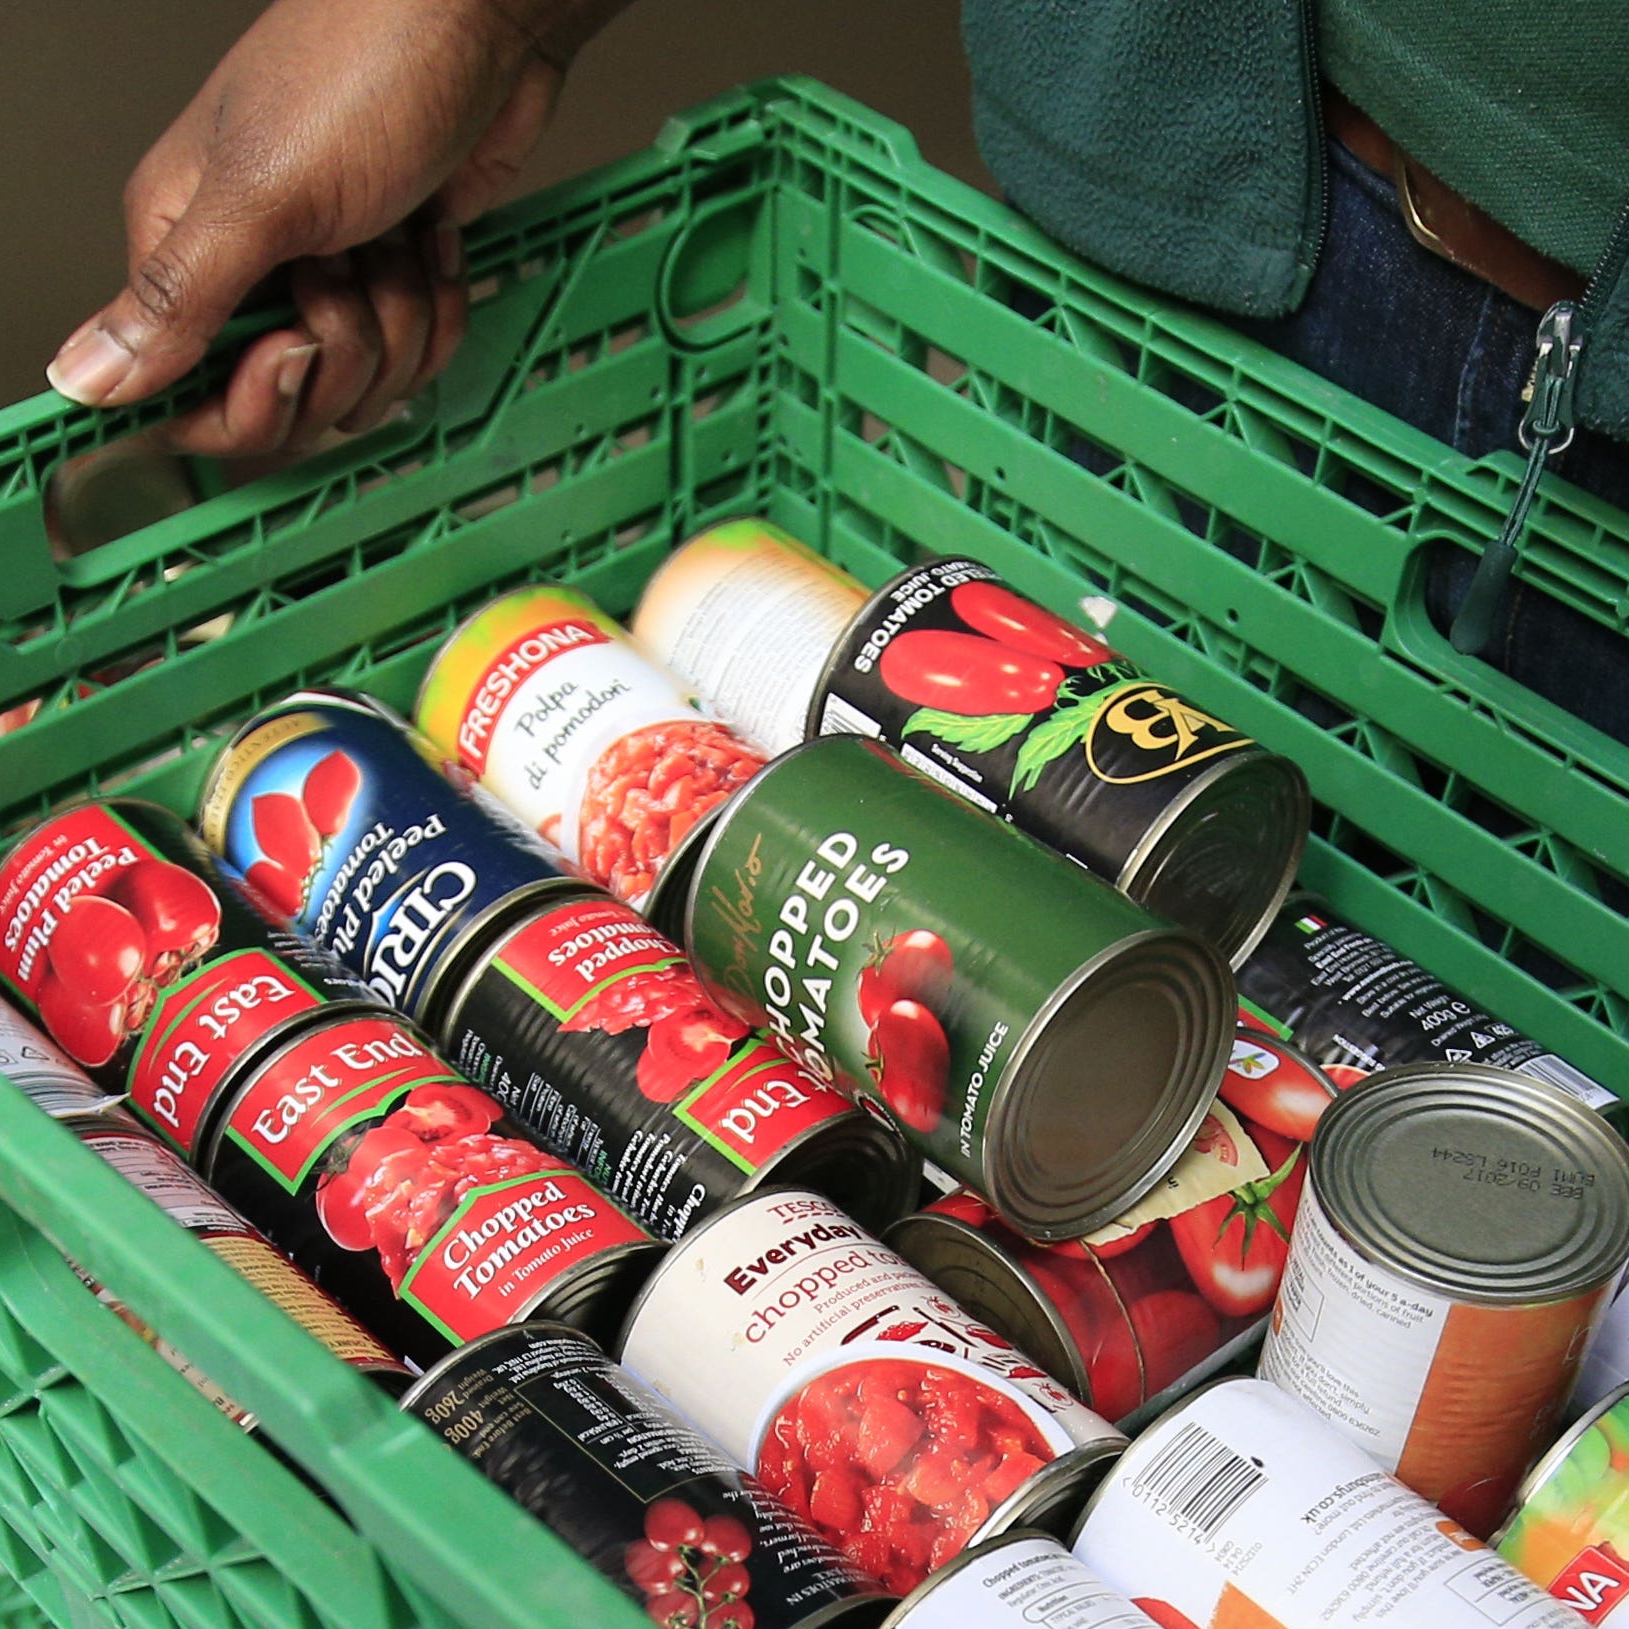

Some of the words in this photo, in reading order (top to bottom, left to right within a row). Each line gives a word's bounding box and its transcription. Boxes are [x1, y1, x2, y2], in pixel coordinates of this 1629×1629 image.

[889, 568, 930, 602] JUICE
[851, 580, 945, 674] TOMATOES
[458, 624, 594, 755] FRESHONA
[511, 674, 578, 740] Polpa
[526, 761, 547, 791] di
[541, 677, 631, 765] pomodori
[11, 841, 55, 889] Tomato
[50, 844, 141, 913] Peeled
[347, 813, 446, 912] Peeled
[3, 834, 108, 952] Tomatoes
[14, 908, 61, 982] Plum
[197, 975, 296, 1041] East
[1407, 1001, 1432, 1022] Net
[1418, 1003, 1457, 1036] 400g
[153, 1041, 211, 1128] End
[251, 1064, 343, 1144] East
[329, 1033, 424, 1070] End
[965, 1063, 990, 1134] TOMATO
[982, 1020, 1009, 1073] JUICE
[719, 1075, 810, 1143] End
[627, 1130, 659, 1173] Tomates
[656, 1150, 688, 1194] Tomates
[1462, 1166, 1540, 1193] 09/2017
[443, 1181, 566, 1271] Chopped
[453, 1202, 596, 1300] Tomatoes
[512, 1244, 561, 1281] Tomato
[561, 1228, 594, 1253] Juice
[722, 1220, 861, 1296] Everyday
[741, 1249, 872, 1345] chopped
[813, 1278, 869, 1314] Produced
[1363, 1277, 1391, 1299] your
[802, 1304, 852, 1347] artificial
[456, 1367, 487, 1390] Weight
[461, 1374, 493, 1399] Drained
[476, 1385, 507, 1409] Weight
[423, 1389, 464, 1425] 260g
[1338, 1390, 1371, 1415] simply
[443, 1407, 484, 1446] 400g
[487, 1418, 515, 1441] Before
[1129, 1481, 1170, 1515] 0112
[1167, 1513, 1203, 1547] 5214
[1311, 1508, 1345, 1537] more?
[1319, 1526, 1352, 1558] London
[981, 1564, 1023, 1589] Chopped
[1345, 1569, 1371, 1591] 0800
[1351, 1590, 1383, 1623] simply
